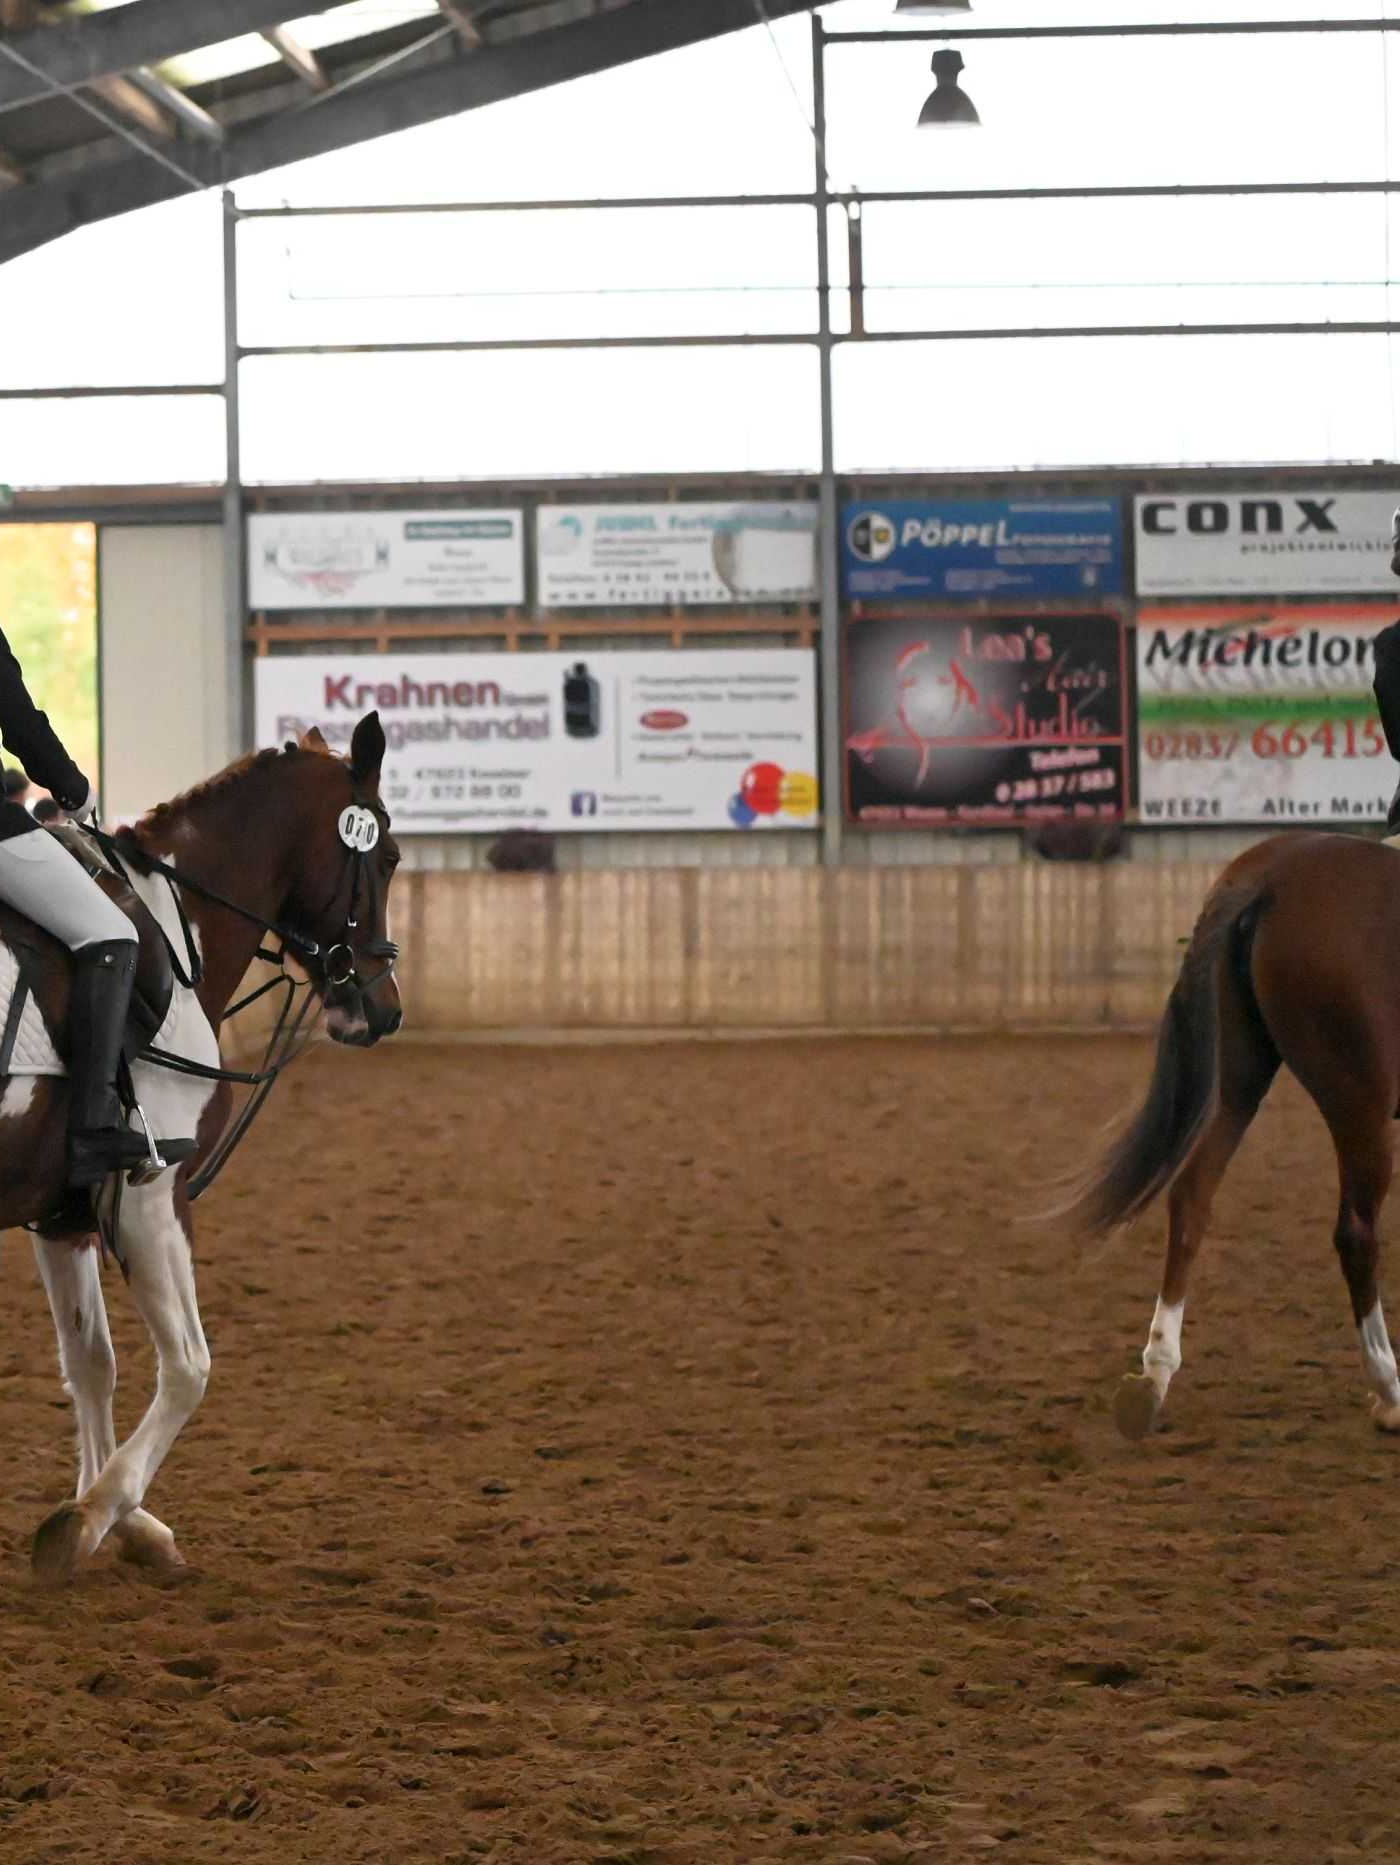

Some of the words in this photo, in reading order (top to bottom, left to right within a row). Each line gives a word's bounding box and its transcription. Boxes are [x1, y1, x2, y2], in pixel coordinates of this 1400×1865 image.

[1141, 498, 1339, 535] conx
[324, 674, 500, 708] Krahnen
[1251, 718, 1385, 760] 66415
[1144, 798, 1222, 817] WEEZE
[1260, 797, 1319, 817] Alter
